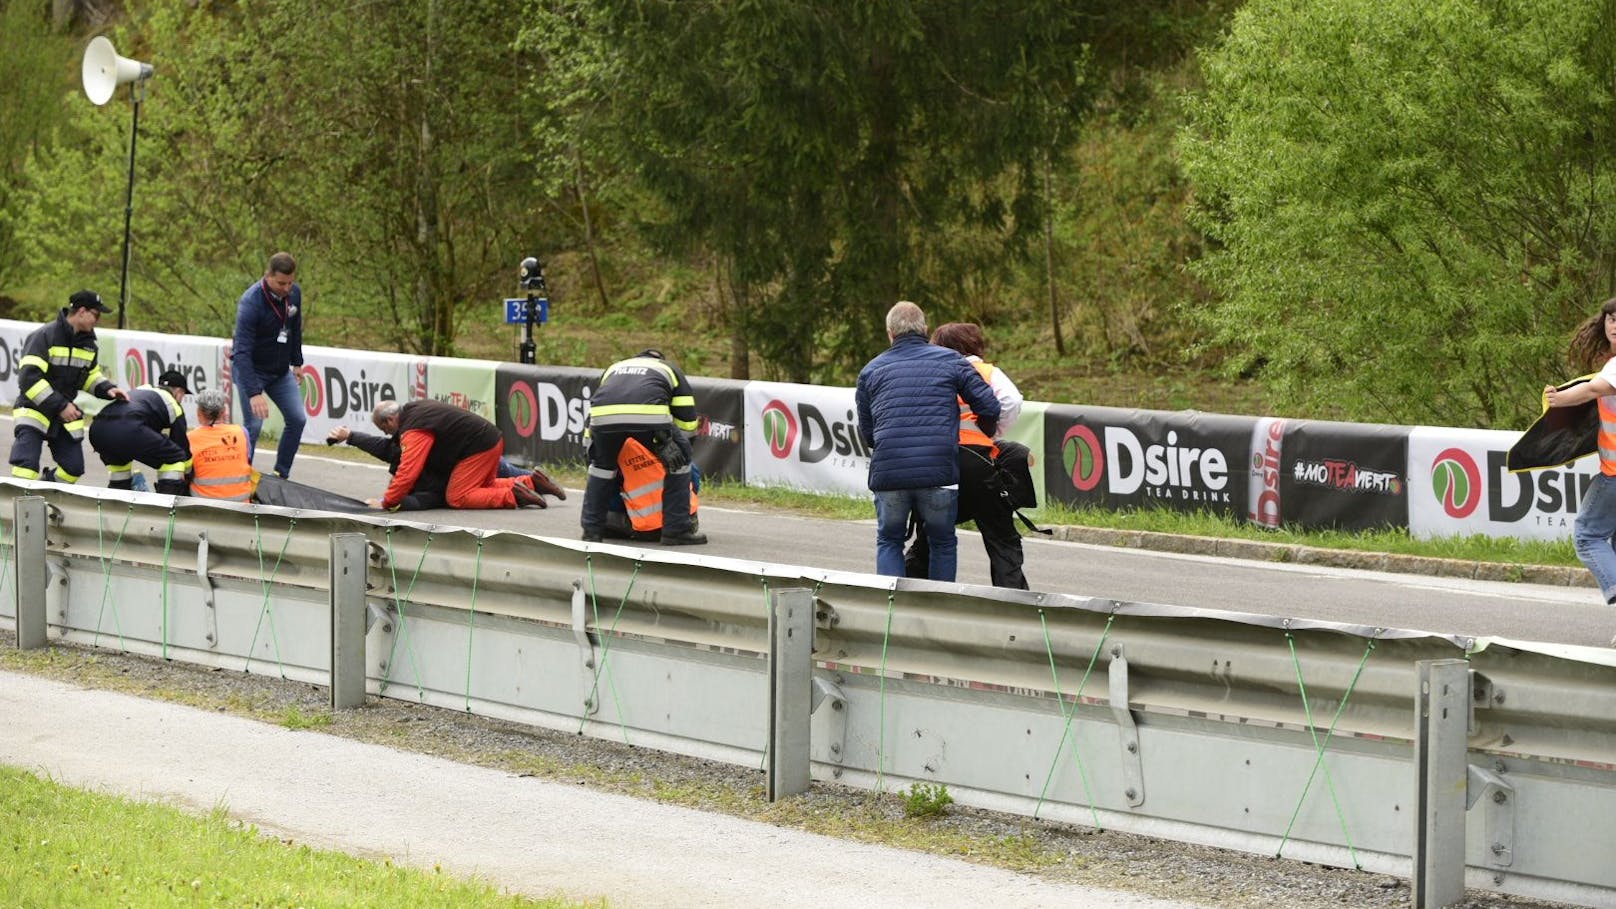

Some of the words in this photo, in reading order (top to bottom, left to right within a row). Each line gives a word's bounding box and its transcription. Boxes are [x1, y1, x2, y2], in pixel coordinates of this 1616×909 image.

[1104, 426, 1228, 495] Dsire
[1146, 486, 1173, 499] TEA
[1182, 490, 1231, 503] DRINK
[1536, 515, 1568, 527] TEA
